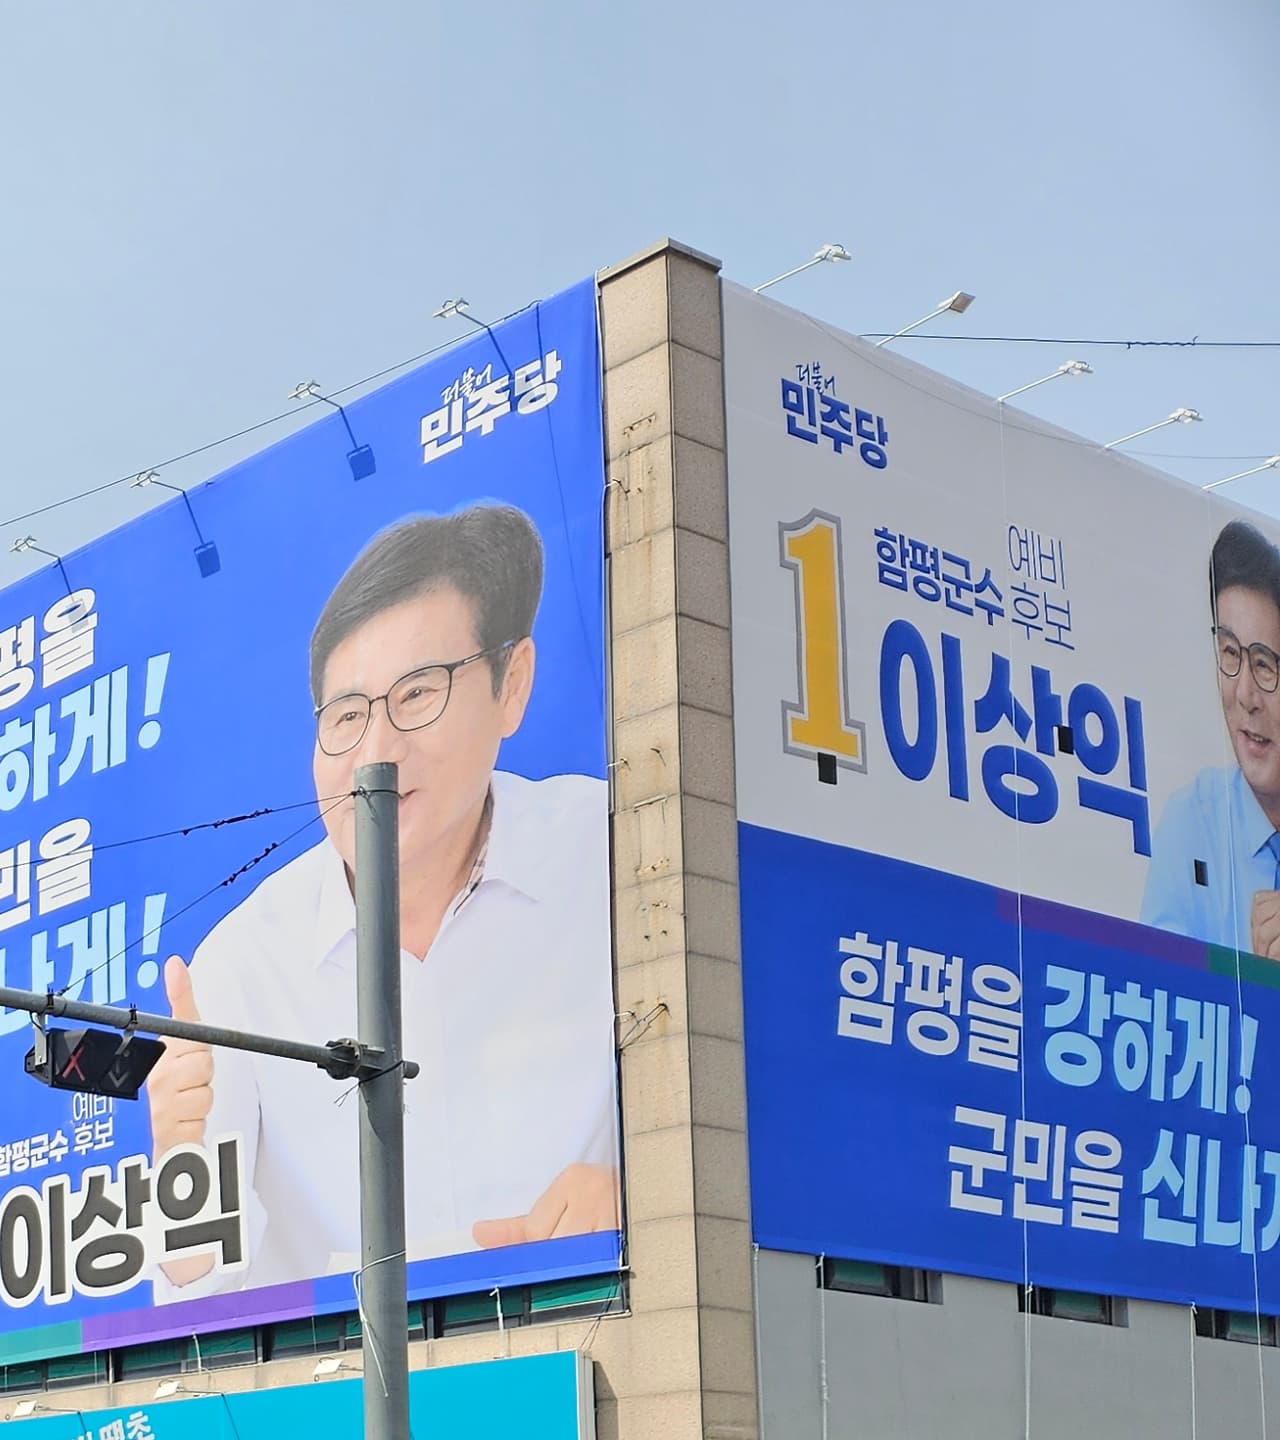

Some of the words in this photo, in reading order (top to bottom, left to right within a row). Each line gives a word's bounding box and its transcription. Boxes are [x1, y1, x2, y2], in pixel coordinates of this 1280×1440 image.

[421, 349, 562, 464] 민주당
[441, 363, 493, 404] 더불어
[781, 377, 889, 470] 민주당
[796, 361, 836, 398] 더불어
[1007, 522, 1066, 591] 예비
[778, 508, 867, 774] 1
[874, 525, 1006, 627] 함평군수
[1010, 584, 1075, 651] 후보
[880, 619, 1152, 857] 이상익
[837, 931, 1024, 1073] 함평을
[1043, 963, 1260, 1114] 강하게!
[73, 1090, 113, 1121] 예비
[73, 1117, 115, 1156] 후보
[948, 1106, 1124, 1235] 군민을
[1142, 1127, 1279, 1254] 신나
